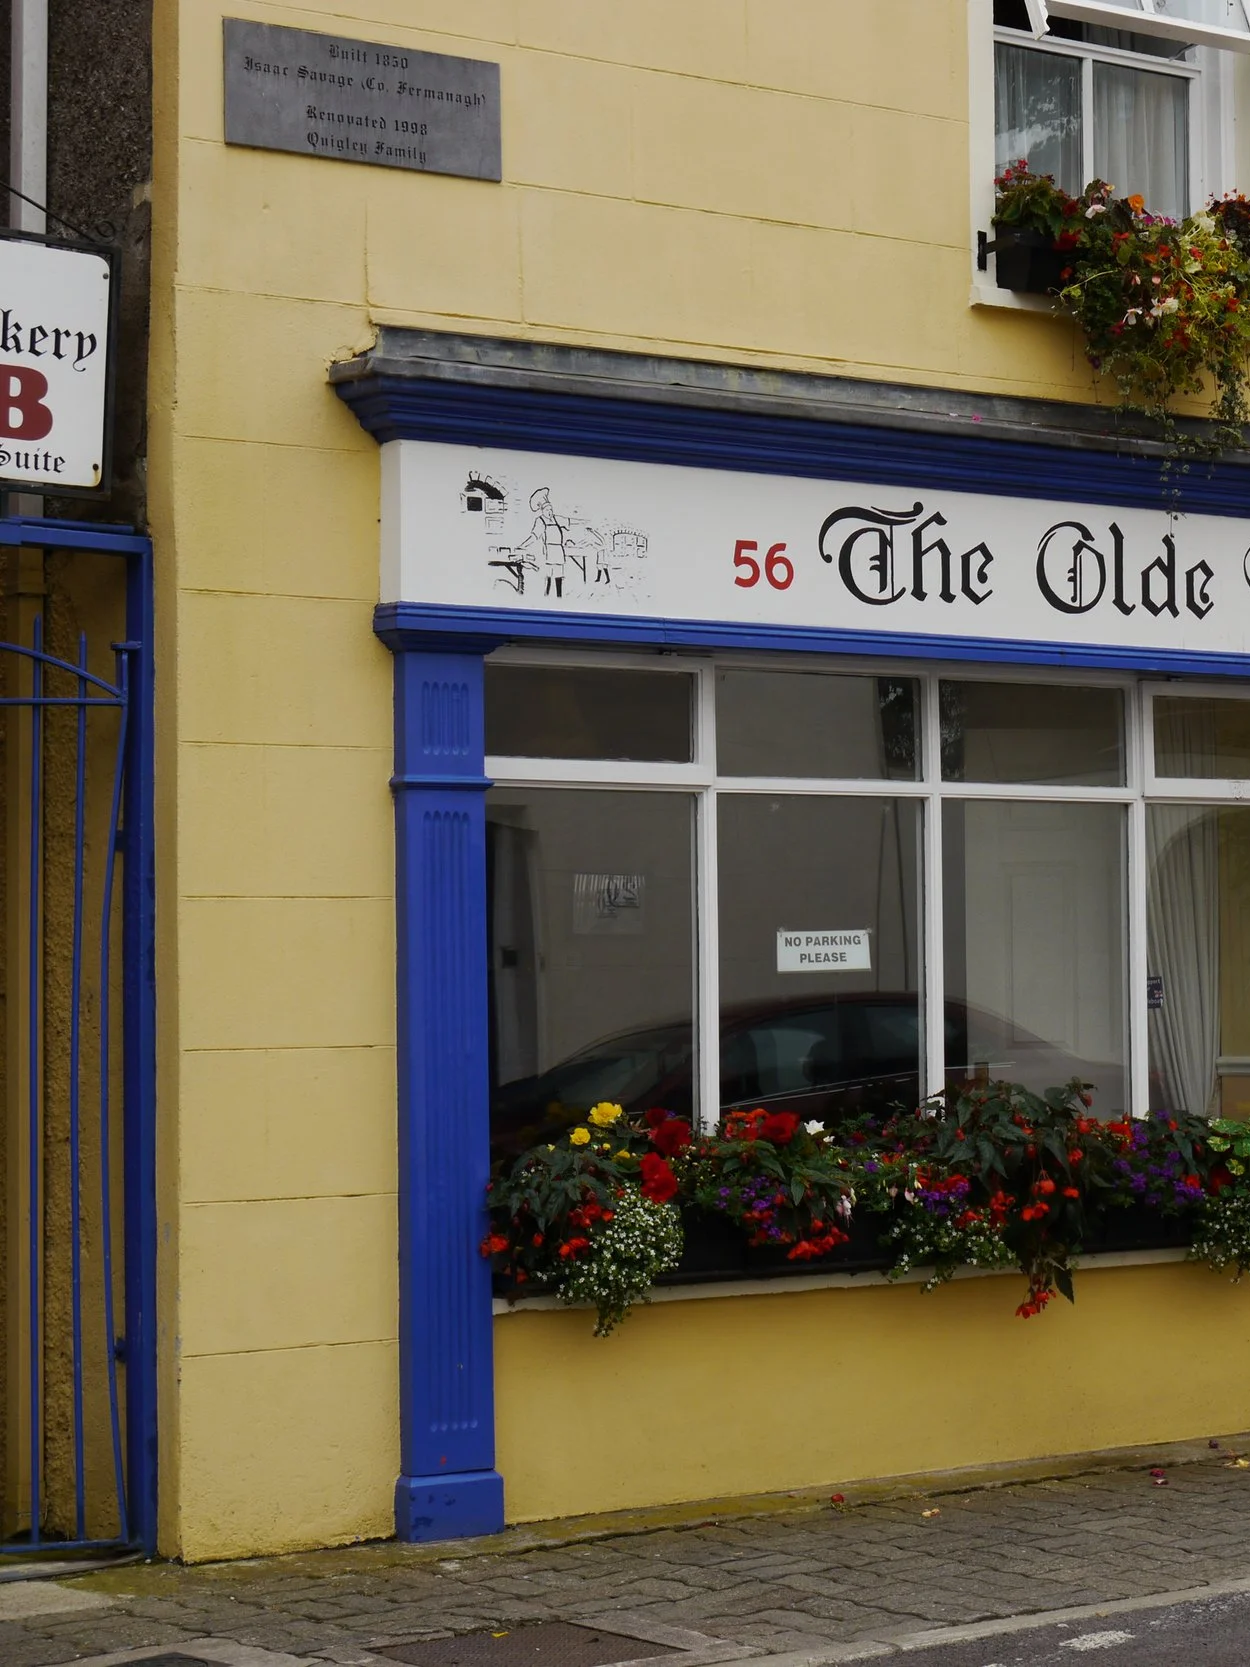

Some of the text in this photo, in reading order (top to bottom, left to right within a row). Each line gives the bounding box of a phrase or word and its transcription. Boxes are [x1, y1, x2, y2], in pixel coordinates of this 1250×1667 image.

[328, 43, 409, 69] Built 1850
[244, 55, 289, 77] Isaac
[297, 64, 354, 89] Savage
[306, 105, 428, 136] Renovated 1998
[306, 131, 427, 164] Quigley Family
[733, 540, 795, 590] 56
[818, 501, 994, 606] The
[1035, 520, 1215, 618] Olde
[785, 935, 861, 947] NO PARKING
[800, 952, 847, 963] PLEASE
